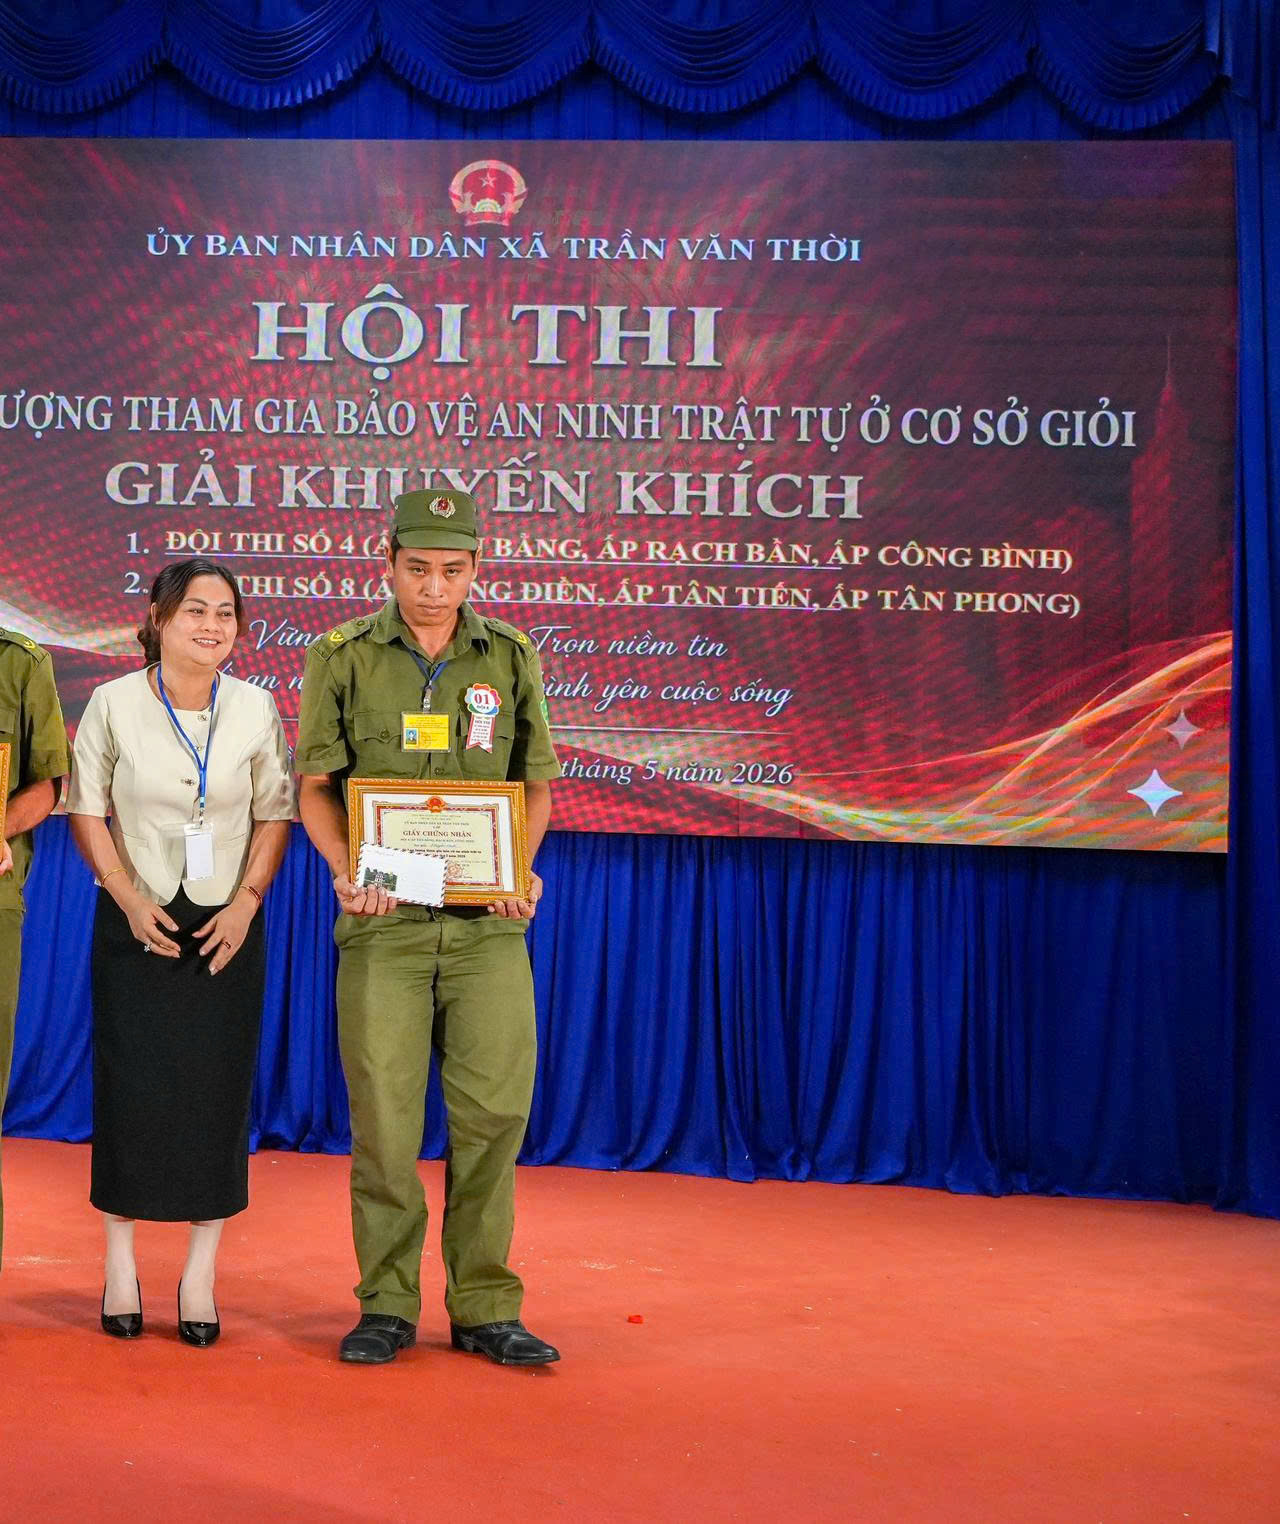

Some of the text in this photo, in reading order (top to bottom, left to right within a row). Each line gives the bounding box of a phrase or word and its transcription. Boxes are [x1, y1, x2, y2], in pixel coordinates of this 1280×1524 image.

[146, 226, 863, 263] ỦY BAN NHÂN DÂN XÃ TRẦN VĂN THỜI
[250, 283, 724, 381] HỘI THI
[122, 395, 244, 434] THAM
[253, 398, 330, 436] GIA
[335, 388, 417, 438] BẢO
[427, 391, 479, 446] VỆ
[486, 401, 544, 438] AN
[554, 402, 663, 442] NINH
[672, 395, 781, 451] TRẬT
[791, 400, 852, 453] TỰ
[858, 393, 892, 445] Ở
[900, 403, 962, 446] CƠ
[972, 396, 1029, 447] SỞ
[1039, 397, 1138, 448] GIỎI
[104, 448, 864, 521] GIẢI KHUYẾN KHÍCH
[126, 531, 150, 554] 1.
[166, 528, 223, 555] ĐỘI
[229, 532, 286, 553] THI
[292, 527, 333, 554] SỐ
[338, 534, 355, 554] 4
[596, 534, 639, 560] ẤP
[645, 540, 738, 564] RẠCH
[826, 538, 870, 565] ẤP
[877, 540, 973, 568] CÔNG
[979, 541, 1073, 574] BÌNH)
[123, 571, 149, 595] 2.
[234, 575, 286, 596] THI
[293, 571, 333, 597] SỐ
[339, 577, 355, 598] 8
[521, 576, 605, 606] ĐIỀN,
[614, 578, 654, 604] ẤP
[661, 579, 727, 606] TÂN
[735, 581, 820, 612] TIẾN,
[827, 583, 870, 609] ẤP
[877, 584, 946, 612] TÂN
[953, 591, 1081, 619] PHONG)
[249, 618, 729, 658] Vữn Trọn niềm tin
[474, 693, 490, 705] 01
[594, 678, 652, 712] yên
[660, 680, 722, 705] cuộc
[729, 677, 794, 717] sống
[560, 757, 795, 786] tháng 5 năm 2026
[422, 829, 449, 837] CHỨNG
